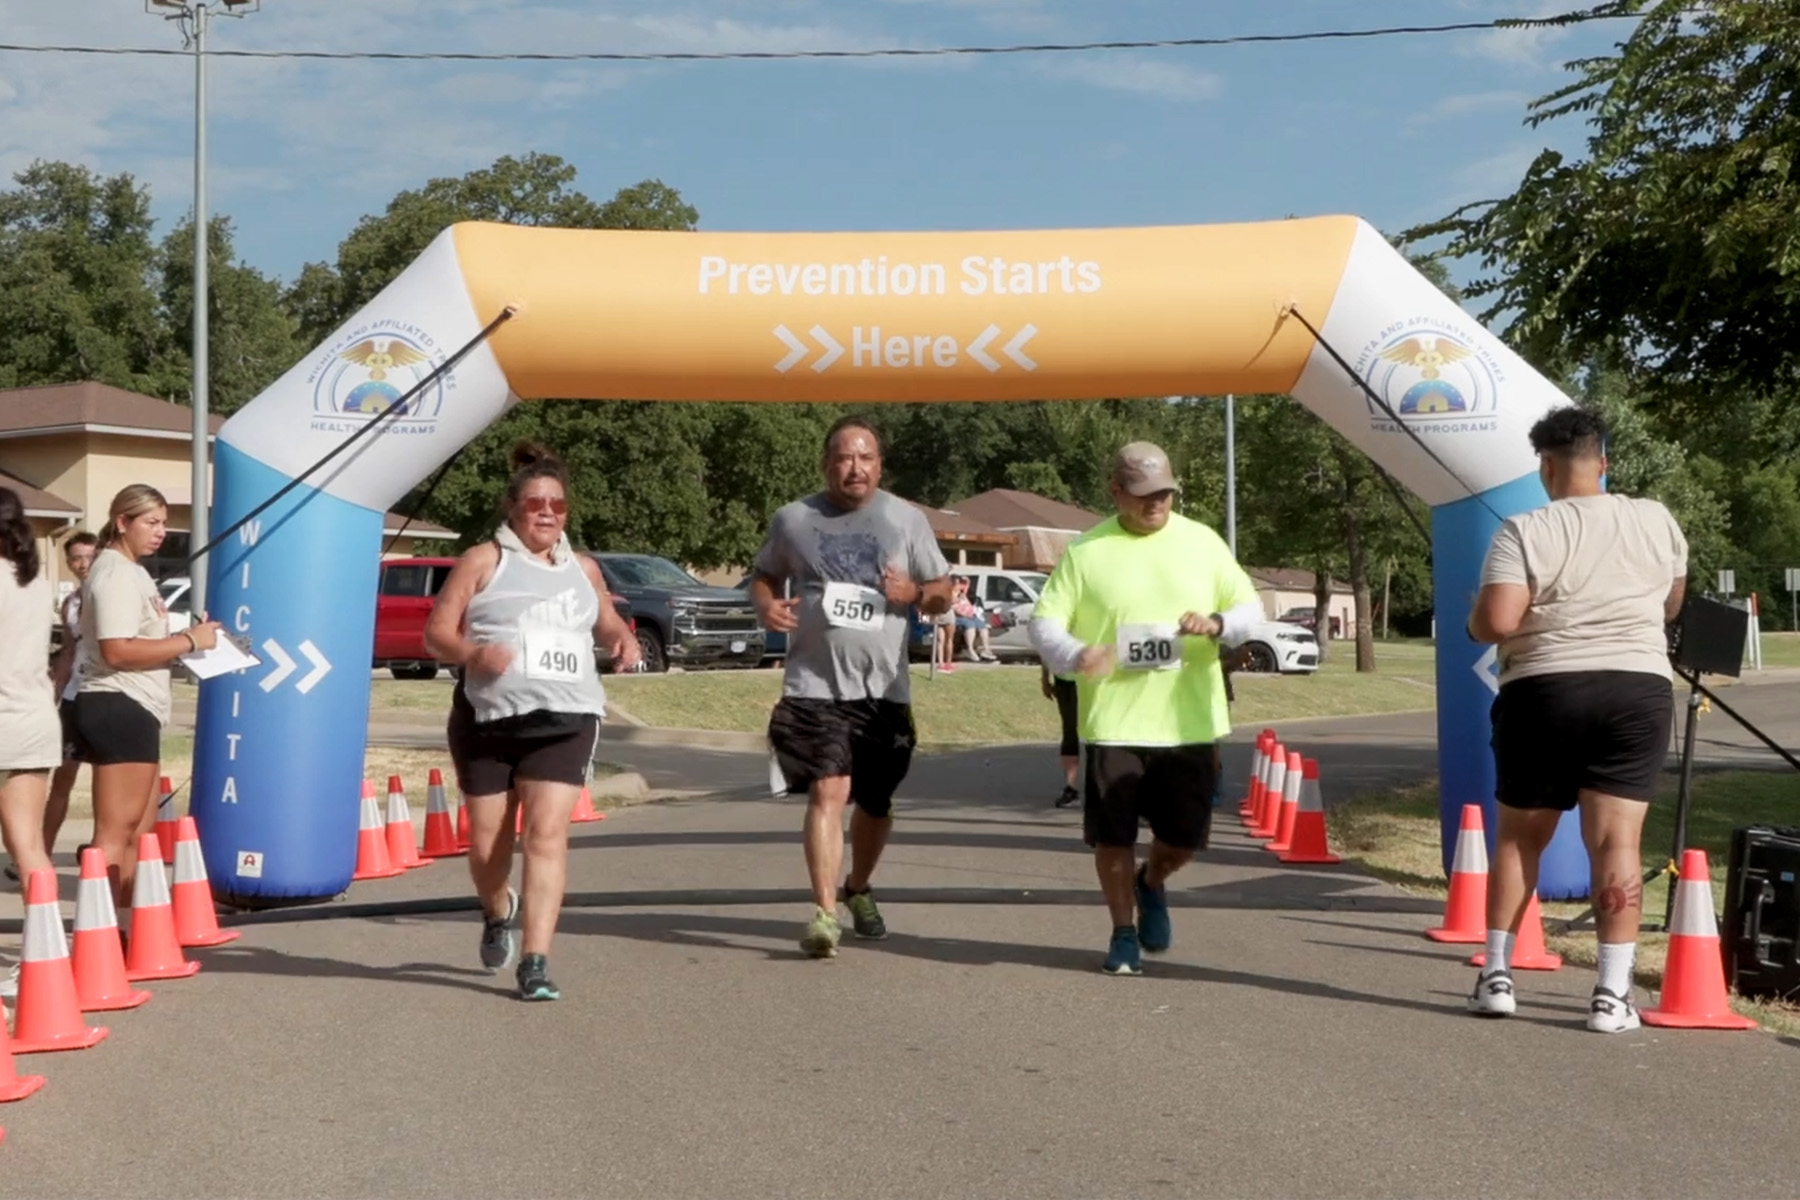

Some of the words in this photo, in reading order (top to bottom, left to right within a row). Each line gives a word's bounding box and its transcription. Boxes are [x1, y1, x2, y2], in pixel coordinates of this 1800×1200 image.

[698, 255, 946, 295] Prevention
[960, 255, 1102, 295] Starts
[1380, 321, 1405, 340] AND
[1408, 316, 1474, 345] AFFILIATED
[306, 342, 343, 384] WICHITA
[346, 325, 369, 343] AND
[371, 319, 435, 348] AFFILIATED
[433, 347, 457, 390] TRBES
[852, 325, 958, 367] Here
[1371, 423, 1421, 433] HEALH
[1424, 422, 1497, 433] PROGRAMS
[832, 598, 875, 622] 550
[221, 519, 261, 804] WICITA
[539, 650, 578, 674] 490
[1128, 639, 1172, 664] 530
